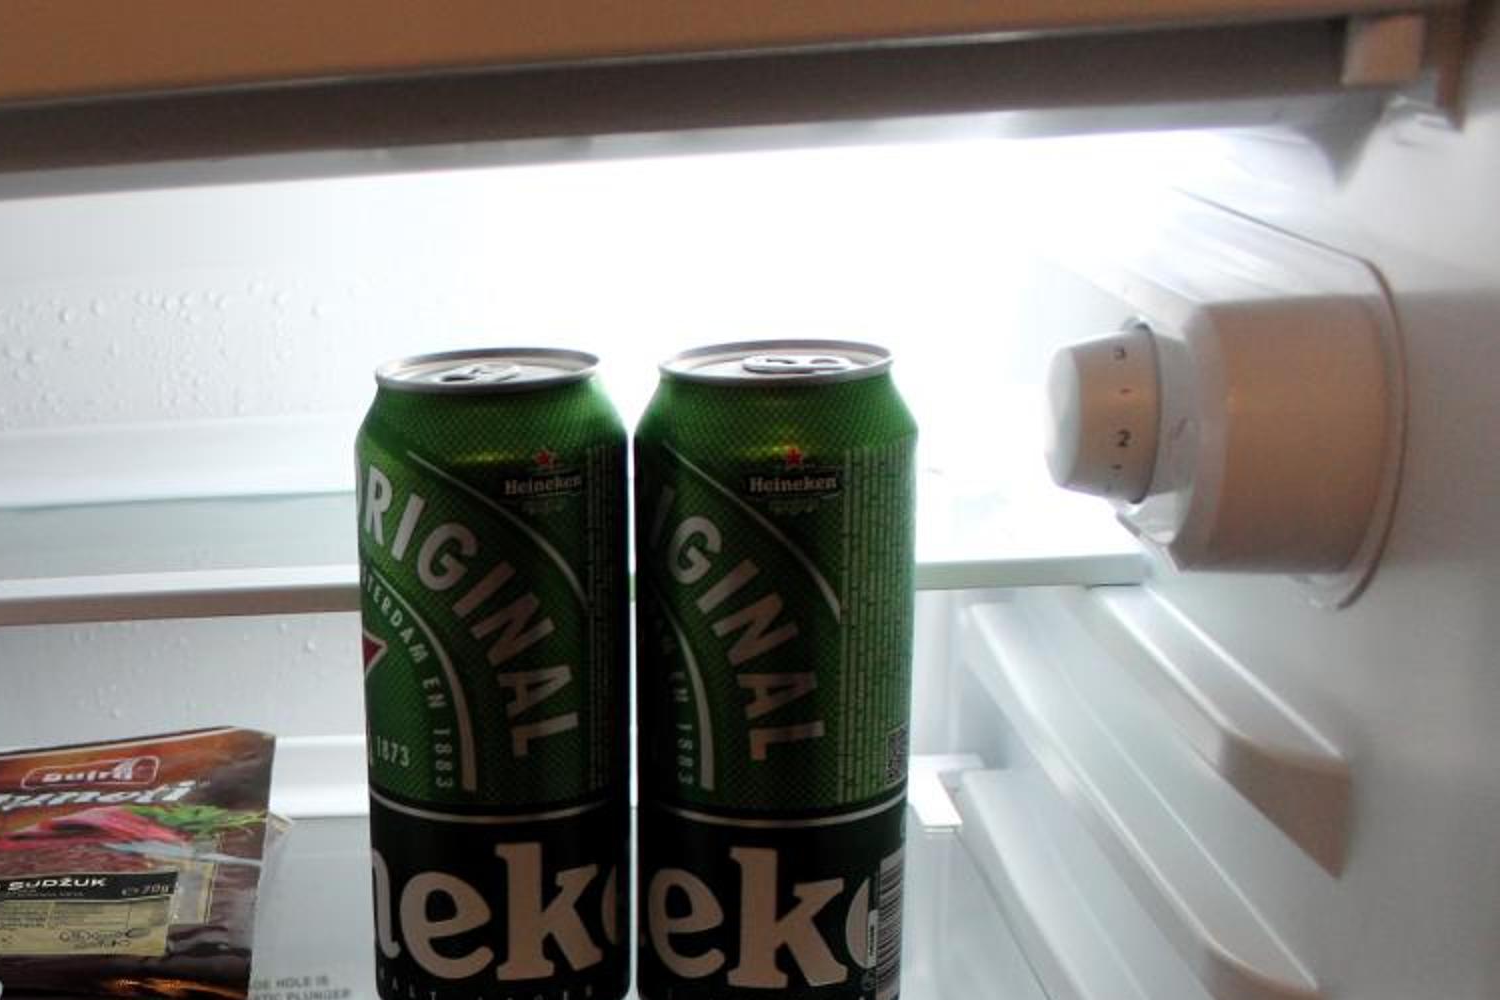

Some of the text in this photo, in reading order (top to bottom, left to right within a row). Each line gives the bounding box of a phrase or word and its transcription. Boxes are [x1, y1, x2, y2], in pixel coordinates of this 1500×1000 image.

[1115, 428, 1132, 447] 2
[749, 476, 837, 494] Heineken
[358, 457, 579, 758] RIGINAL
[433, 728, 454, 789] 1883
[7, 876, 107, 893] SUDŽUK
